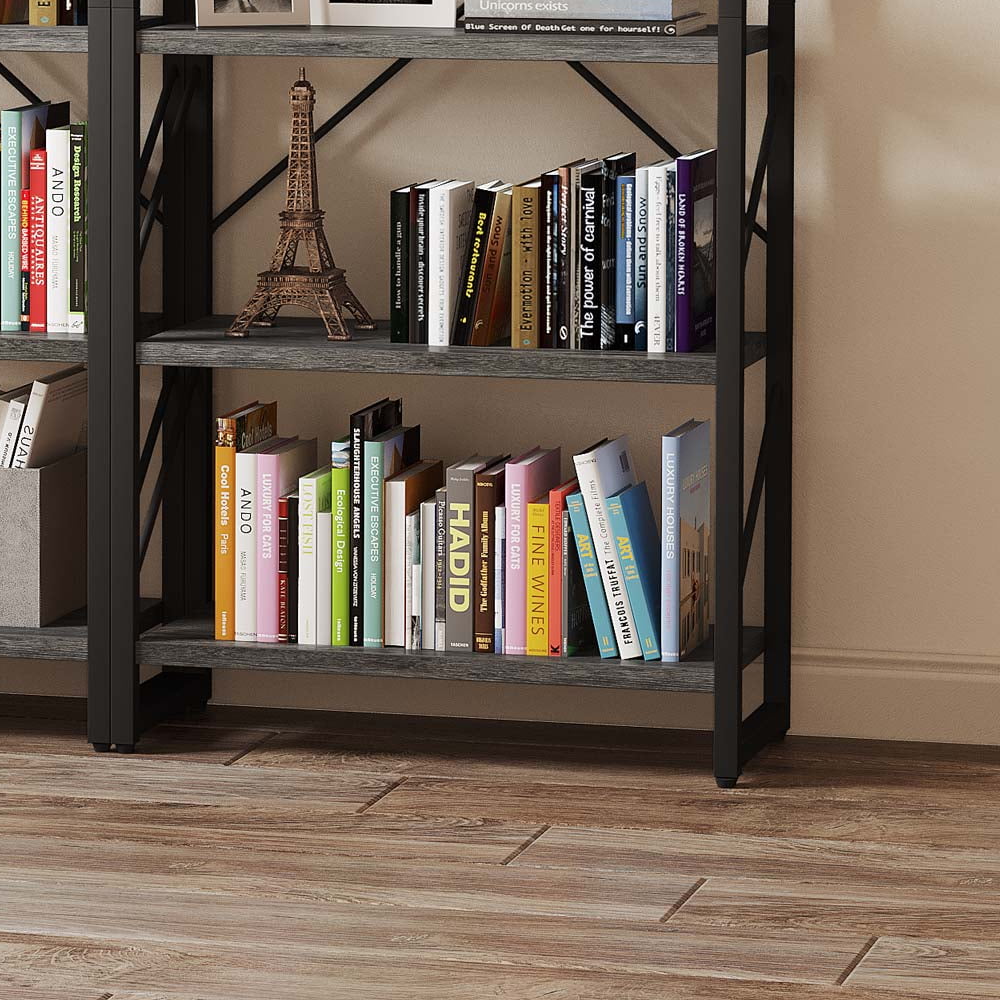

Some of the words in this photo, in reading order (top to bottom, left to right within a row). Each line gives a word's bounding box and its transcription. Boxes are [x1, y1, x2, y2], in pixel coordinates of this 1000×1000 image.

[480, 0, 533, 12] Unicorns
[535, 2, 569, 12] exists
[489, 23, 517, 31] Screen
[521, 23, 532, 31] Of
[535, 24, 560, 32] Death
[561, 24, 576, 32] Get
[7, 126, 17, 187] EXECUTIVE
[72, 145, 82, 177] Design
[52, 168, 64, 217] ANDO
[73, 180, 81, 222] Research
[520, 197, 533, 220] love
[560, 184, 568, 223] Perfect
[678, 194, 686, 216] LAND
[7, 190, 17, 240] ESCAPES
[476, 212, 487, 235] Best
[581, 187, 596, 242] carnival
[638, 197, 647, 235] Snow
[678, 218, 686, 228] OF
[33, 196, 44, 286] ANTIQUAIRES
[520, 228, 533, 252] with
[560, 225, 568, 256] Story
[581, 244, 595, 262] of
[636, 238, 647, 260] and
[677, 230, 686, 262] BROKEN
[417, 261, 425, 294] discover
[465, 237, 482, 298] restaurants
[637, 265, 647, 288] Sun
[677, 265, 686, 295] HEARTS
[520, 270, 533, 330] Evermotion
[582, 265, 598, 308] power
[417, 294, 425, 322] secrets
[580, 312, 594, 339] The
[653, 315, 661, 346] 4EVER
[220, 464, 230, 489] Cool
[353, 428, 361, 504] SLAUGHTERHOUSE
[665, 452, 675, 503] LUXURY
[262, 473, 272, 512] LUXURY
[370, 456, 379, 513] EXECUTIVE
[588, 479, 600, 501] Films
[220, 491, 230, 526] Hotels
[240, 488, 252, 534] ANDO
[302, 483, 313, 520] LOST
[334, 489, 346, 537] Ecological
[437, 500, 445, 527] Picasso
[511, 483, 521, 521] LUXURY
[262, 514, 272, 532] FOR
[353, 506, 361, 539] ANGELS
[511, 524, 521, 544] FOR
[592, 502, 609, 539] Complete
[665, 506, 675, 559] HOUSES
[220, 533, 229, 554] Paris
[262, 534, 272, 559] CATS
[302, 524, 313, 556] FISH
[370, 515, 379, 562] ESCAPES
[437, 528, 445, 556] Guitars
[531, 525, 545, 566] FINE
[575, 533, 593, 559] ART
[602, 541, 611, 555] The
[616, 536, 633, 561] ART
[335, 540, 346, 573] Design
[449, 502, 470, 612] HADID
[510, 545, 521, 570] CATS
[604, 559, 621, 598] TRUFFAT
[531, 575, 545, 635] WINES
[614, 601, 633, 645] FRANCOIS
